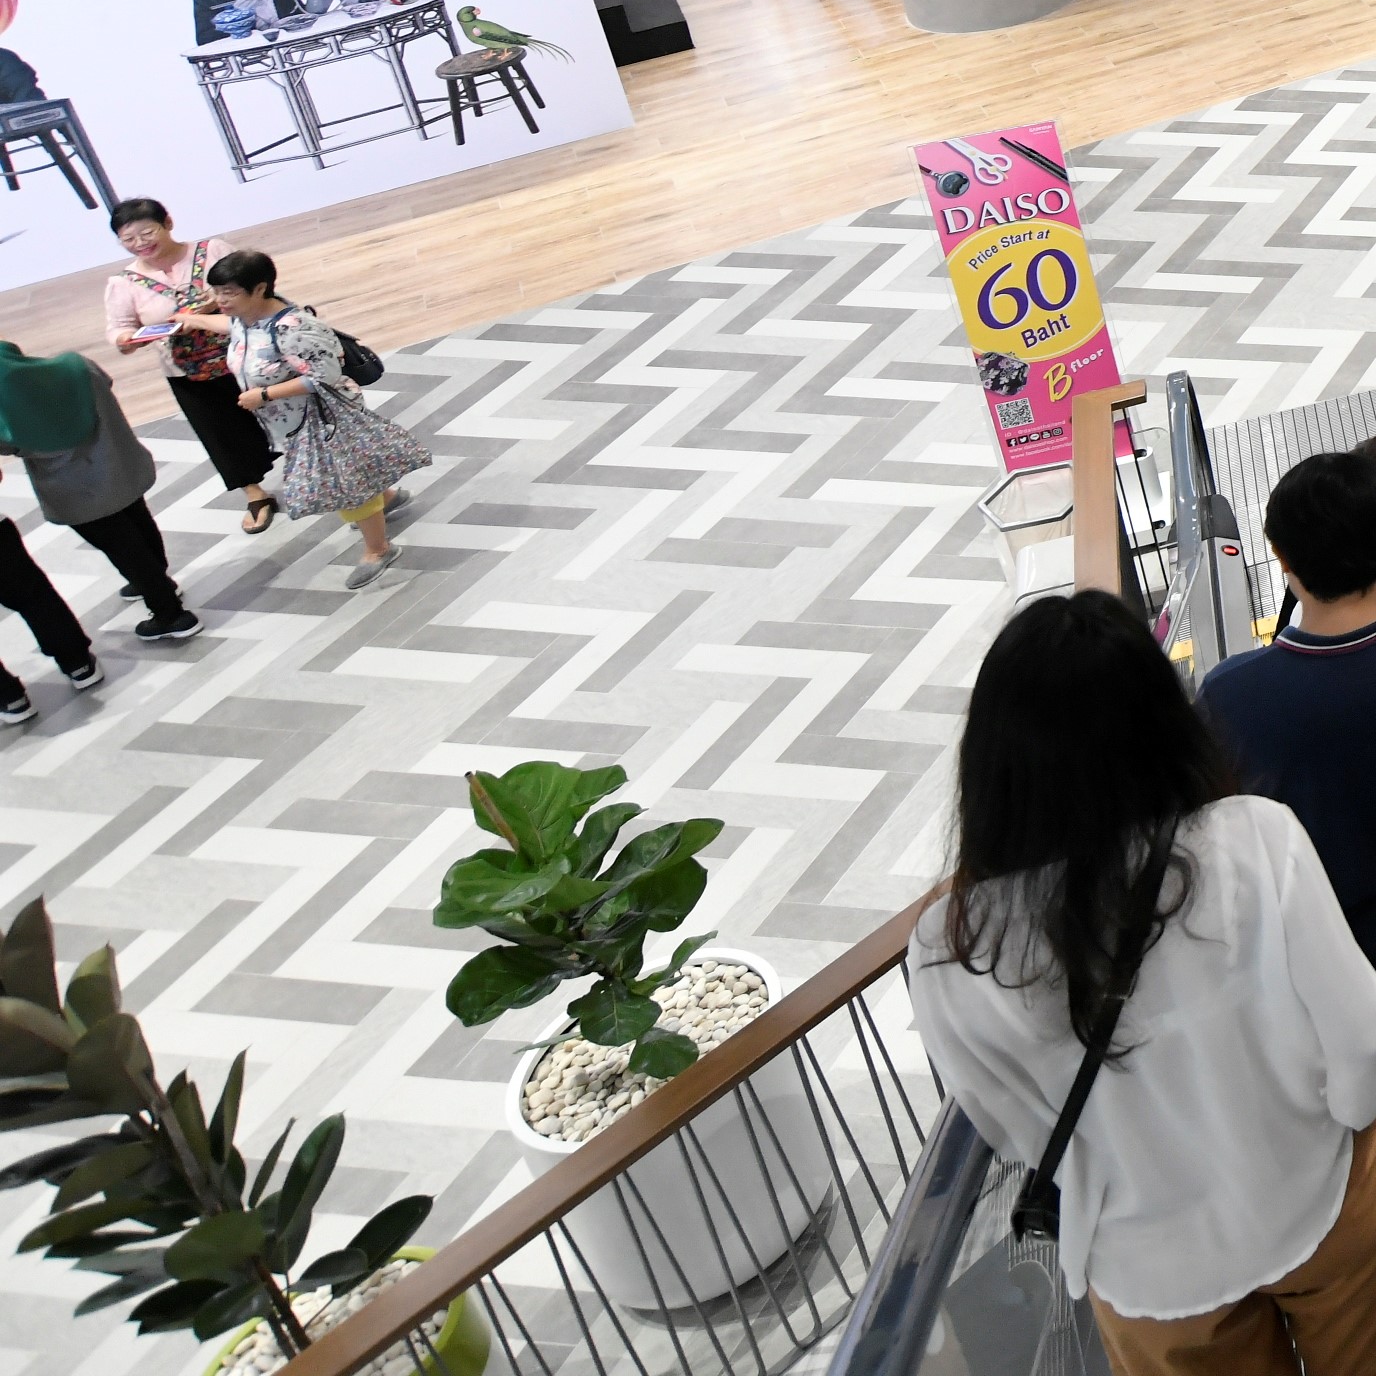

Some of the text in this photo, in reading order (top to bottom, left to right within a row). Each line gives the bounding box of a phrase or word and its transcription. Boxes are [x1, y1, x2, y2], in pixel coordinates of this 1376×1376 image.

[942, 187, 1071, 235] DAISO
[968, 229, 1051, 270] Price Start at
[977, 249, 1077, 330] 60
[1021, 313, 1071, 348] Baht
[1043, 363, 1073, 403] B
